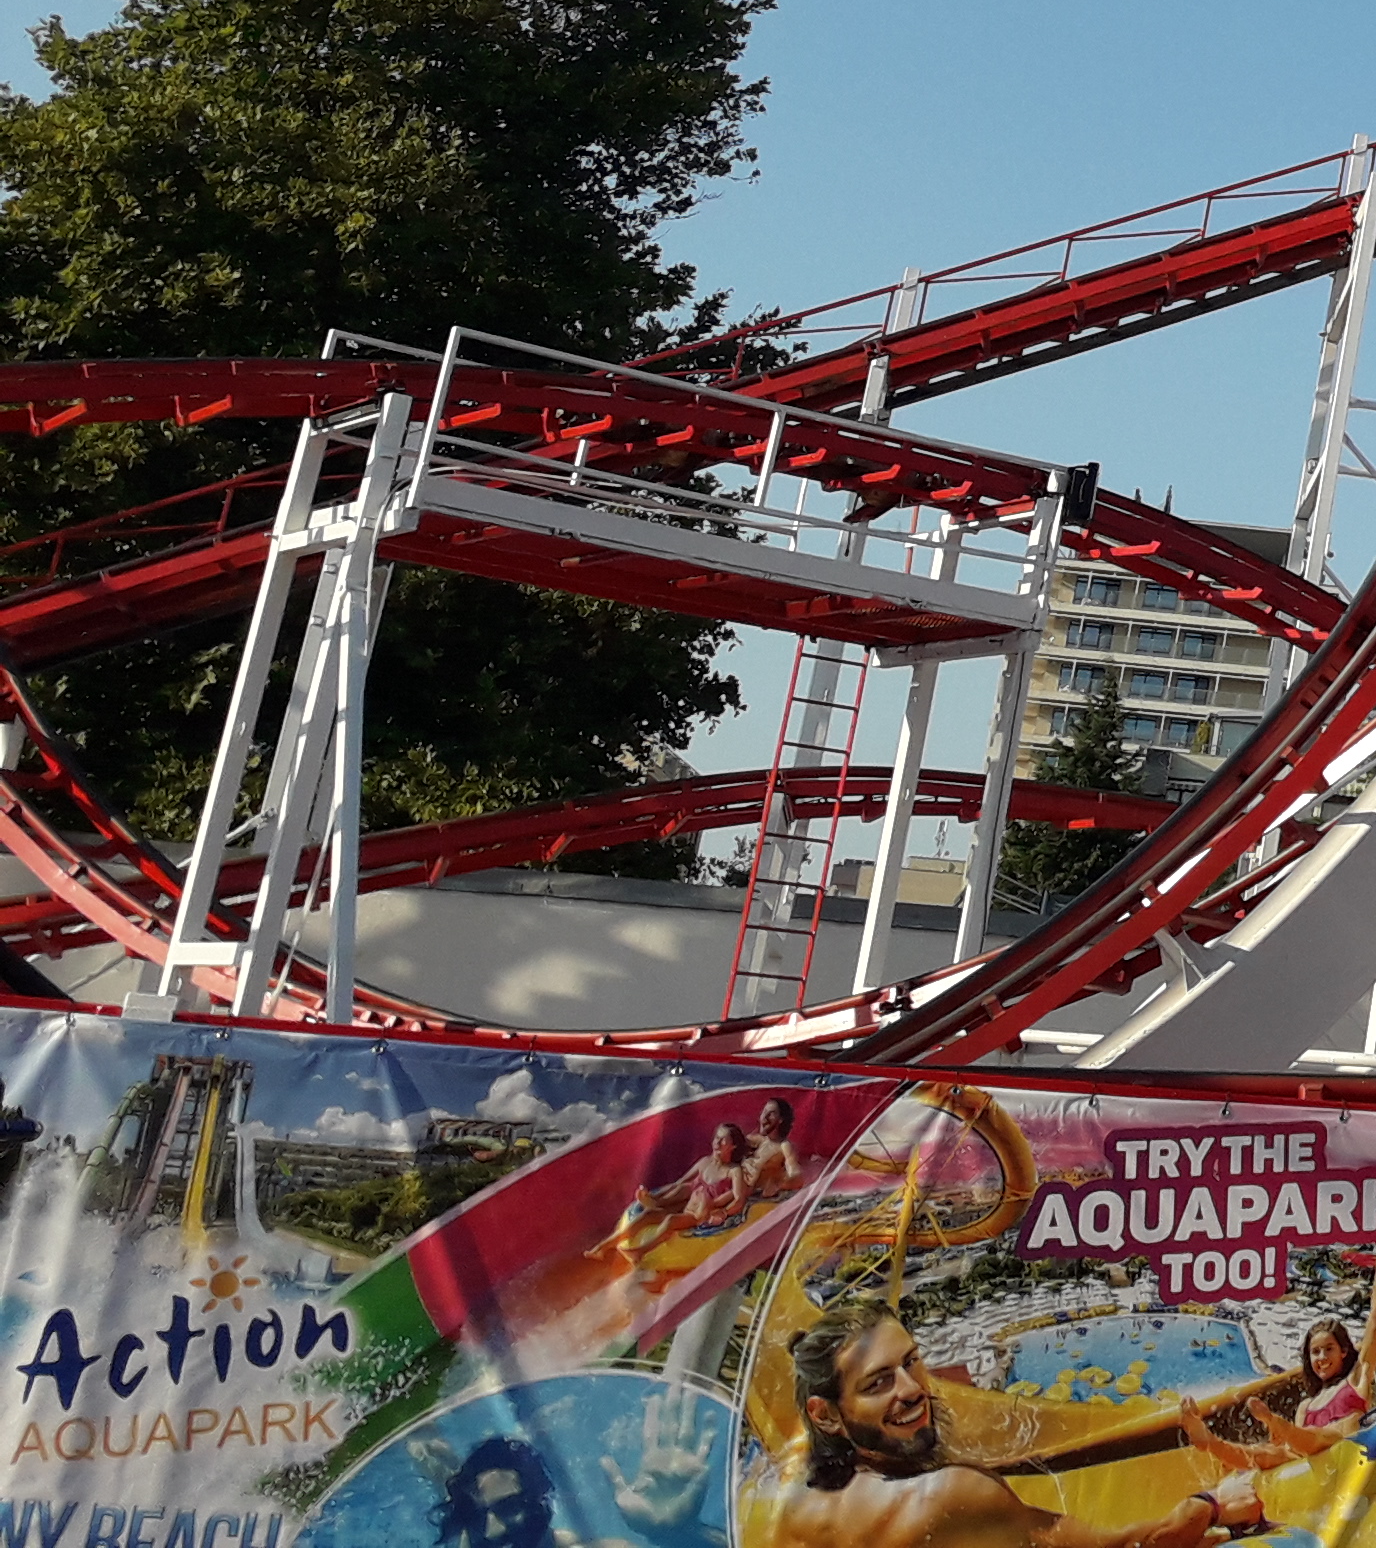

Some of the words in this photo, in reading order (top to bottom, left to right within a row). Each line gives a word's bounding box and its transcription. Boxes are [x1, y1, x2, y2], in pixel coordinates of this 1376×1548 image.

[1115, 1137, 1214, 1180] TRY
[1220, 1133, 1316, 1175] THE
[1161, 1246, 1277, 1294] TOO!
[16, 1294, 350, 1411] Action
[10, 1399, 340, 1465] AQUAPARK
